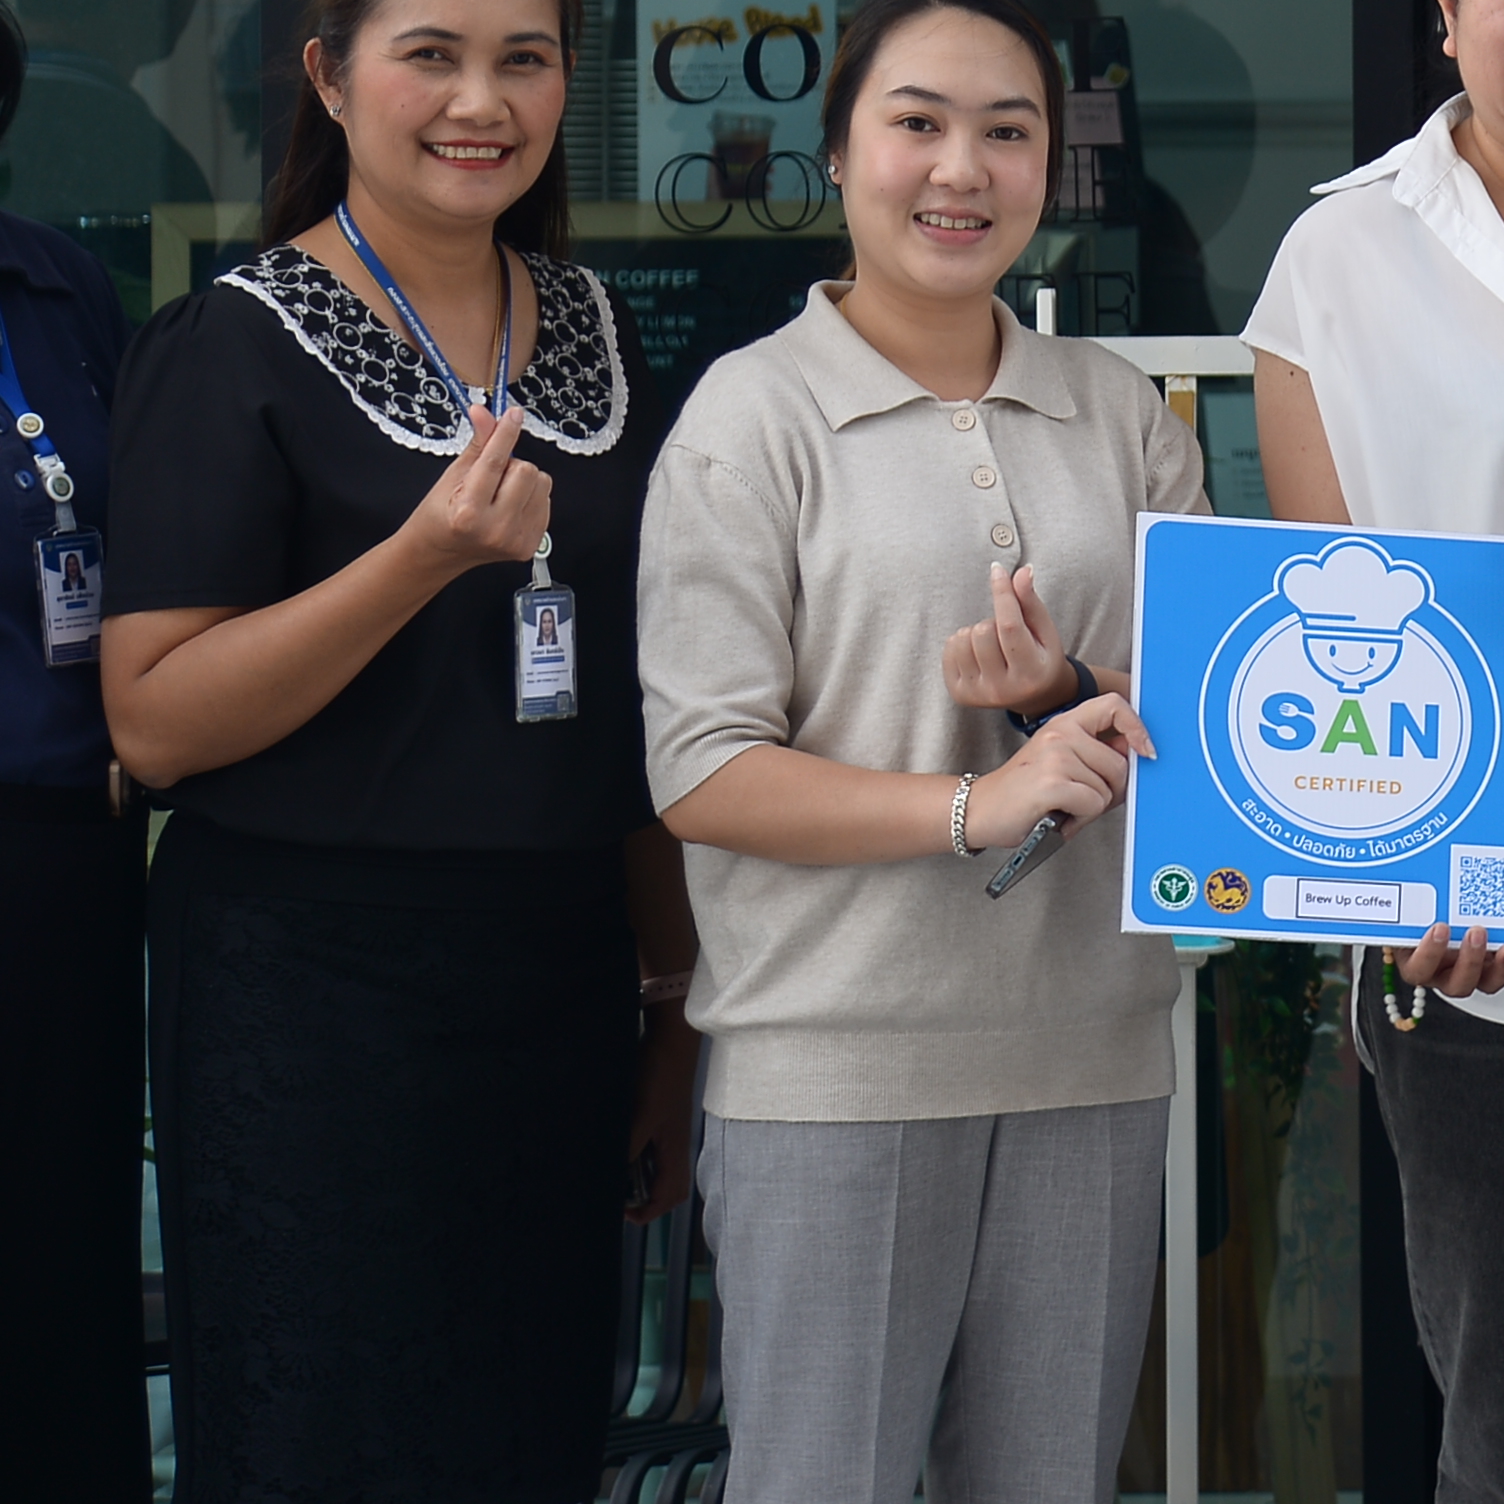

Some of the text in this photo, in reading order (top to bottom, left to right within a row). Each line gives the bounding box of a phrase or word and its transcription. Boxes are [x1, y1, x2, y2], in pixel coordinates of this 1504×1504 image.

[614, 269, 700, 290] COFFEE
[1258, 692, 1440, 759] SAN
[1295, 776, 1402, 794] CERTIFIED
[1241, 797, 1449, 860] สะอาด ปลอดภัย ได้มาตรฐาน
[1305, 892, 1393, 909] Brew Up Coffee
